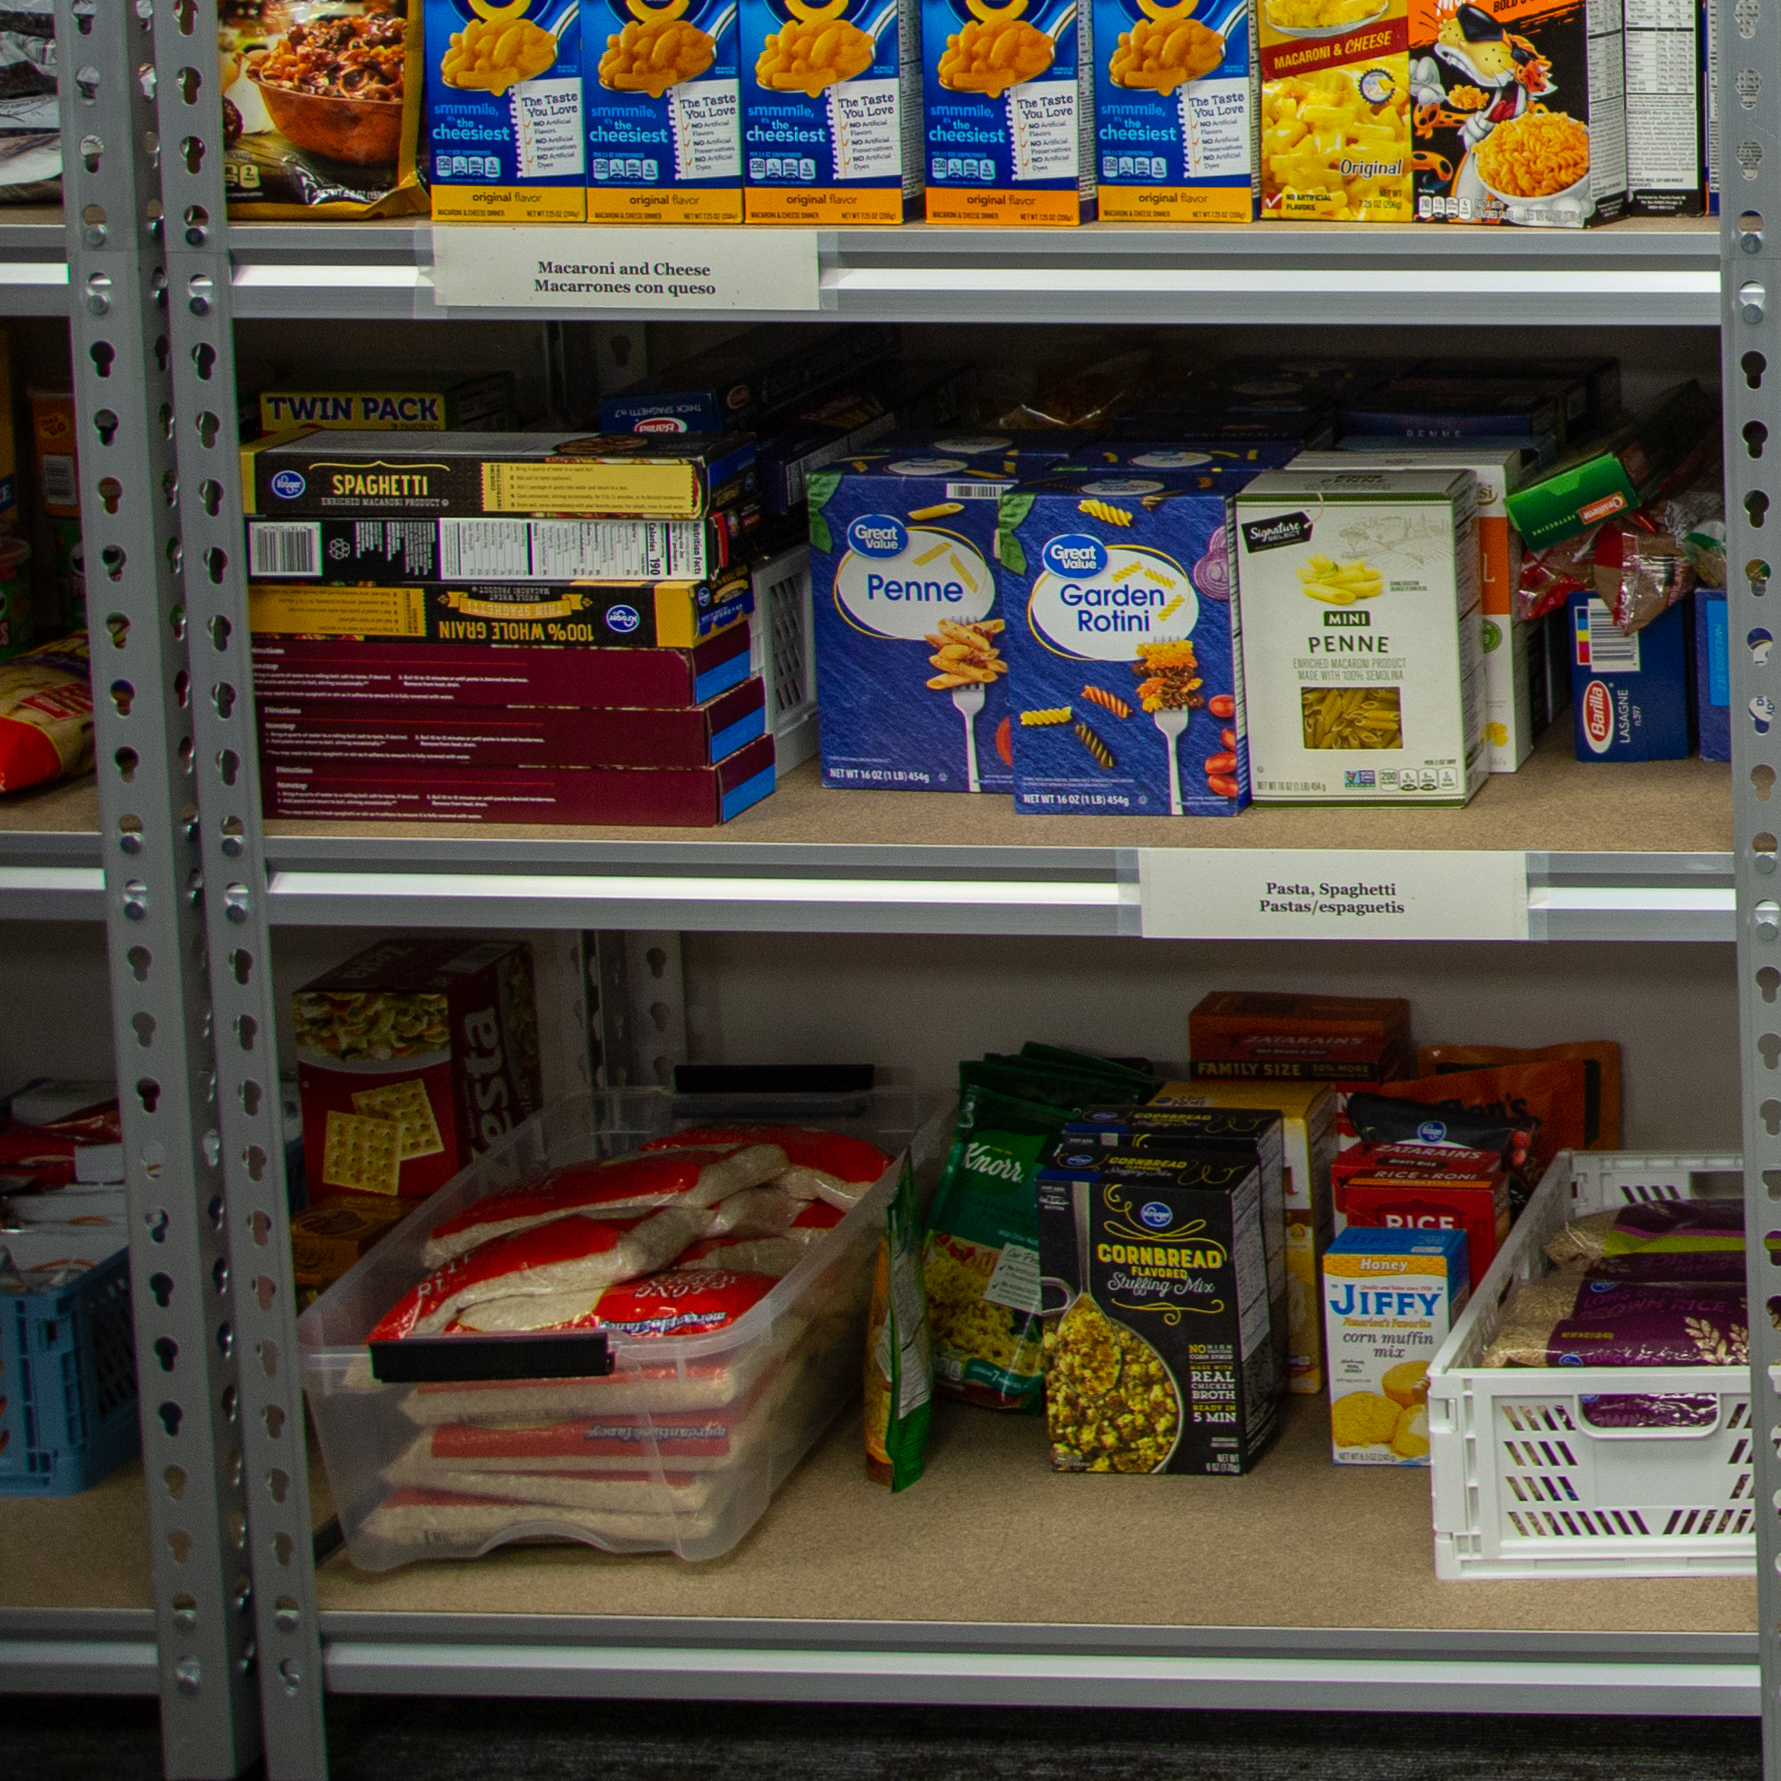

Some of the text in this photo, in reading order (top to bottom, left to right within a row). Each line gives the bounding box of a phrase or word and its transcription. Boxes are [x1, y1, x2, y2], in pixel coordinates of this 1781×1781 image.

[1274, 31, 1392, 70] MACARONI & CHEESE
[522, 91, 578, 107] The Taste
[526, 104, 578, 119] You Love
[432, 125, 510, 141] cheesiest
[1340, 159, 1402, 178] Original
[538, 261, 711, 277] Macaroni and Cheese
[534, 279, 716, 298] Macarrones con queso
[265, 394, 438, 422] TWIN PACK
[333, 475, 428, 496] SPAGHETTI
[855, 525, 898, 549] Great Value
[868, 575, 964, 602] Penne
[1060, 585, 1165, 607] Garden
[1078, 610, 1150, 632] Rotini
[1591, 683, 1607, 748] Barilla
[1620, 688, 1630, 743] LASAGNE
[1266, 882, 1396, 900] Pasta, Spaghetti
[1259, 899, 1405, 916] Pastas/espaguetis
[1097, 1243, 1223, 1270] CORNBREAD
[1190, 1370, 1236, 1383] REAL
